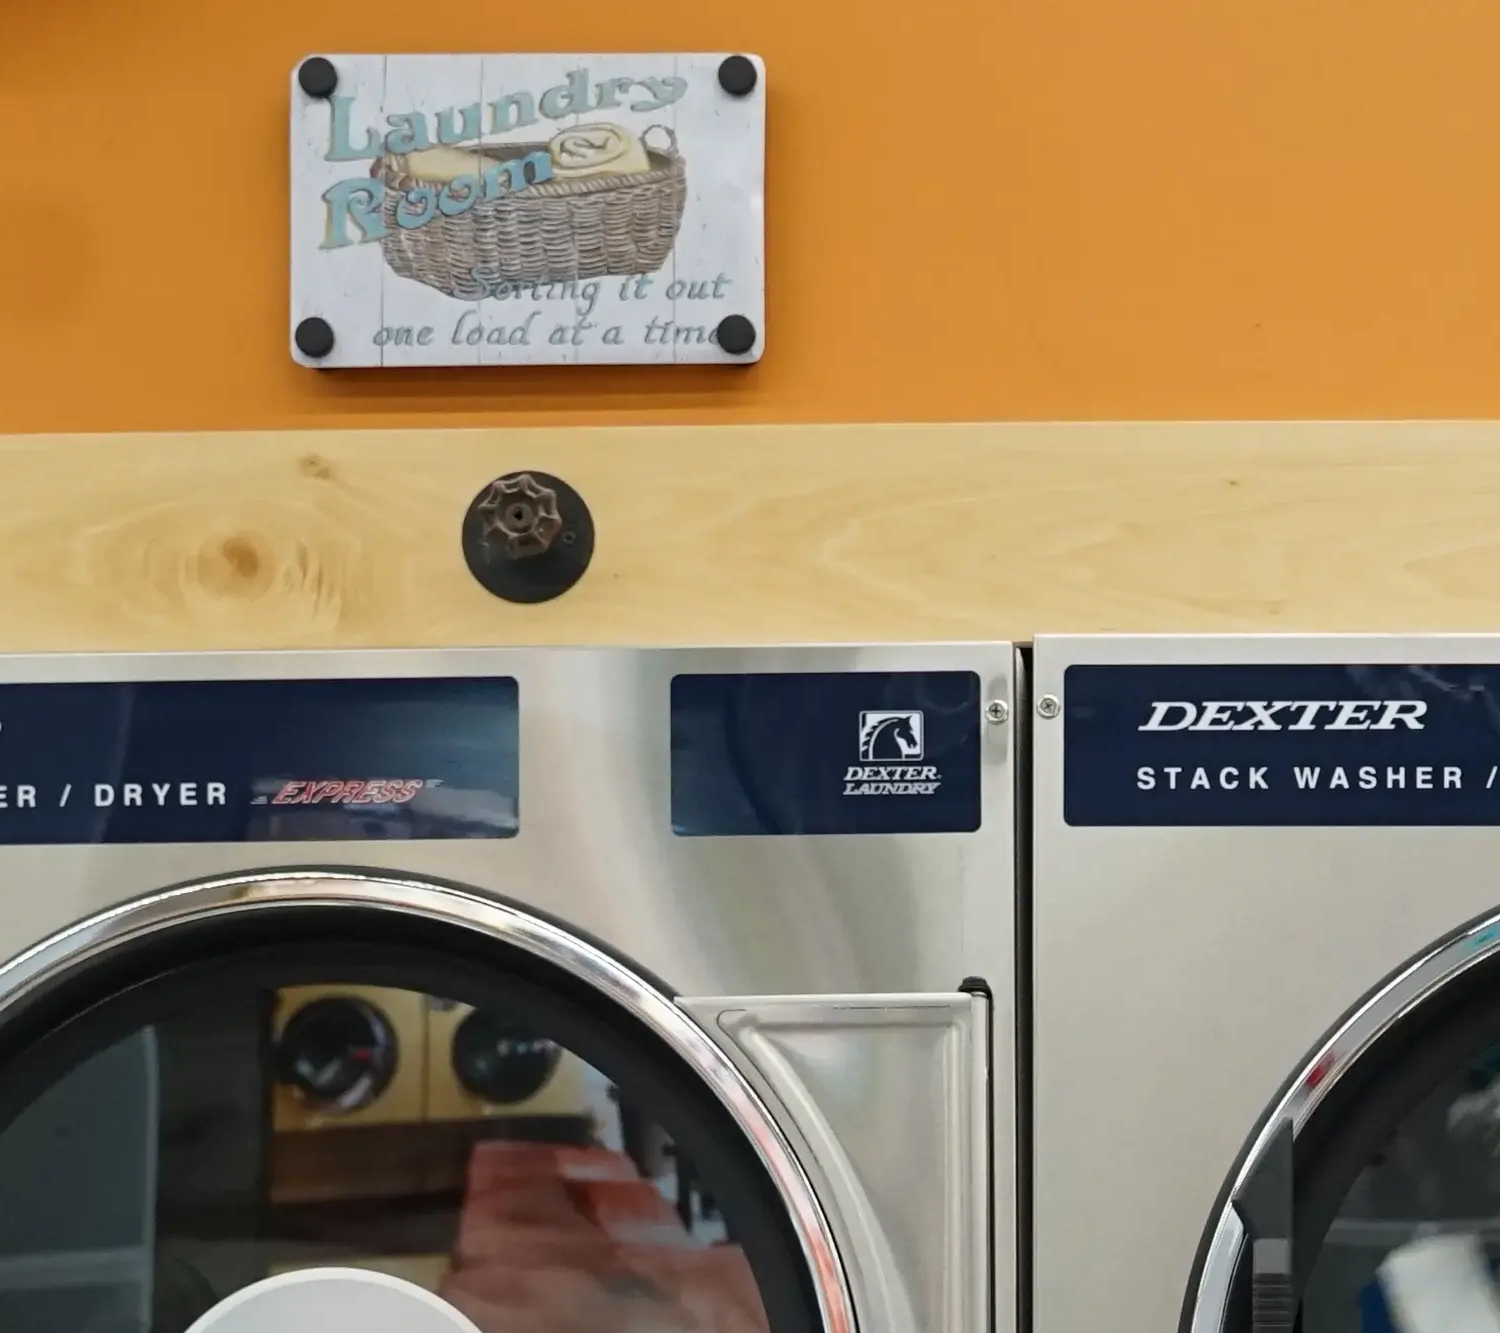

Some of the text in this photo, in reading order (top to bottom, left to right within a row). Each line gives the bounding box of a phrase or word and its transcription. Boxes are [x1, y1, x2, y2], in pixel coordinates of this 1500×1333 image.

[325, 67, 687, 162] Laundry
[318, 149, 557, 250] Room
[460, 267, 731, 315] Sorting it out
[373, 325, 433, 347] one
[451, 310, 541, 347] load
[548, 319, 585, 346] at
[601, 327, 624, 345] a
[1138, 701, 1427, 730] DEXTER
[844, 766, 942, 780] DEXTER
[1138, 767, 1268, 789] STACK
[1294, 767, 1461, 789] WASHER
[95, 783, 225, 806] DRYER
[270, 779, 427, 805] EXPRESS
[843, 782, 941, 796] LAUNDRY
